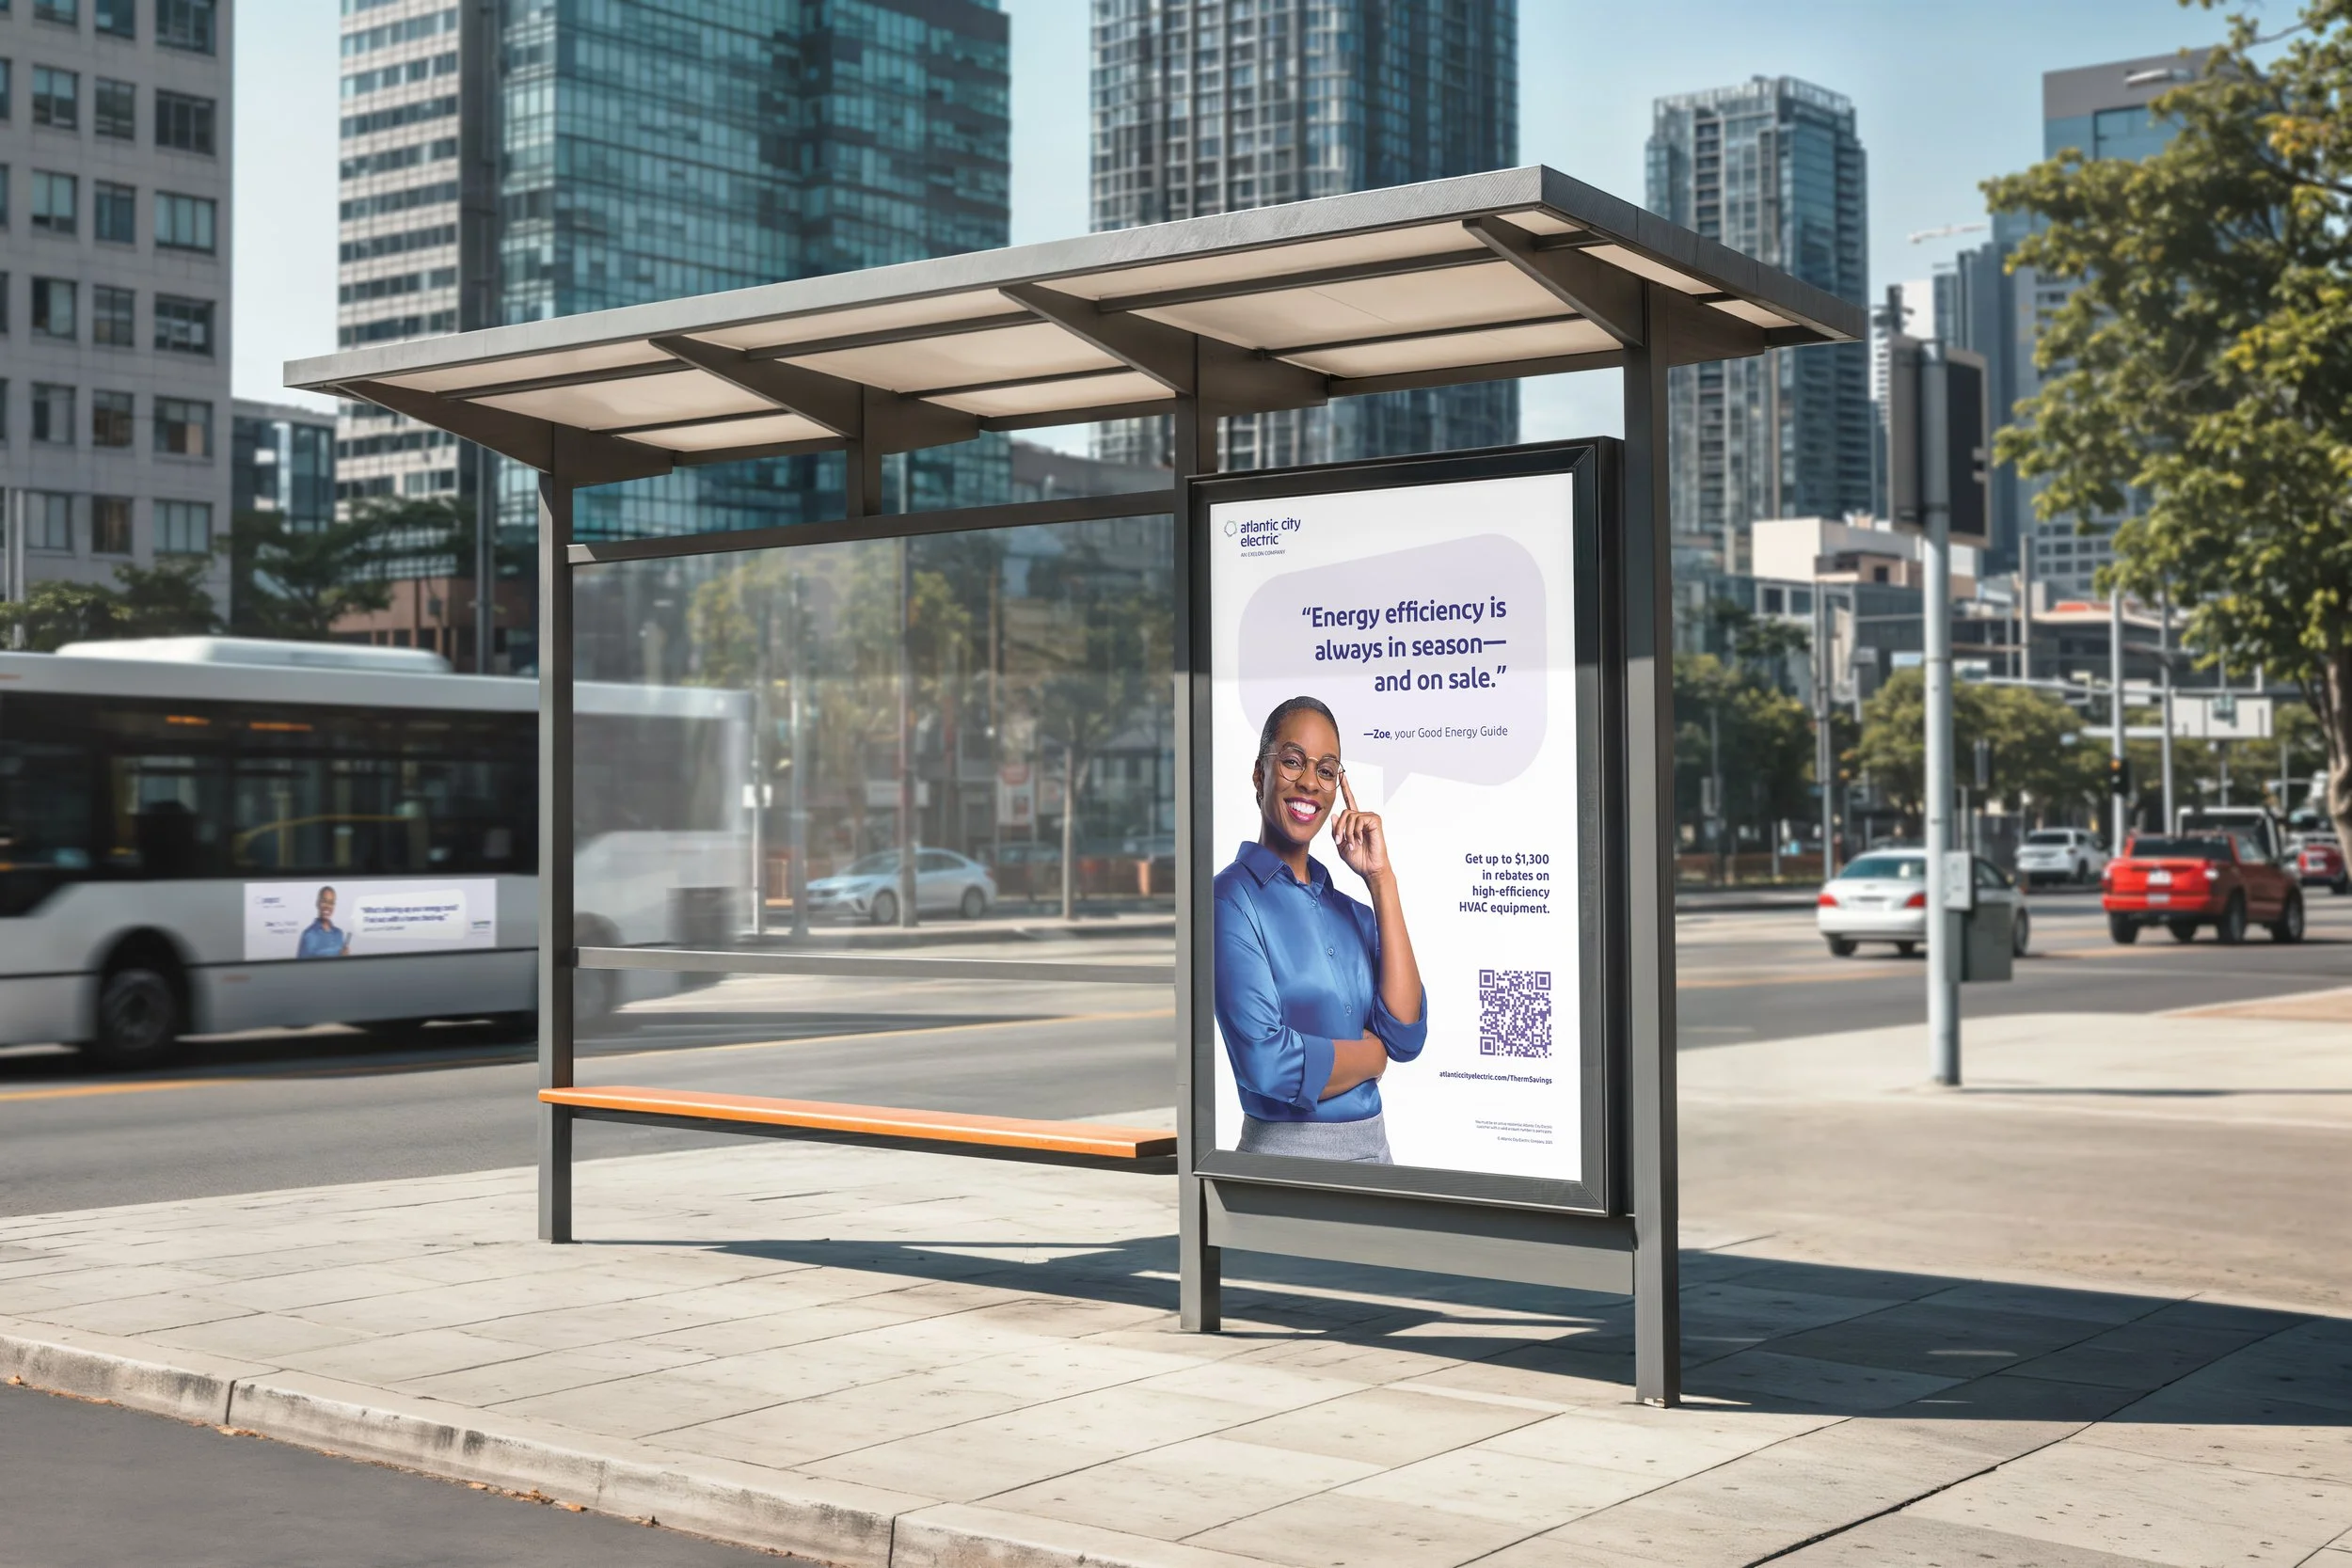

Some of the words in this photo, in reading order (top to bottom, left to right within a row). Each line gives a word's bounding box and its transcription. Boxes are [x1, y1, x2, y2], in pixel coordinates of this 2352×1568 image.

[1240, 518, 1279, 533] atlantic
[1281, 516, 1301, 531] city
[1302, 607, 1380, 630] “Energy
[1385, 599, 1485, 624] efficiency
[1490, 596, 1507, 617] is
[1315, 640, 1383, 664] always
[1389, 636, 1406, 657] in
[1375, 670, 1411, 691] and
[1417, 673, 1442, 690] on
[1449, 665, 1507, 689] sale.”
[1394, 730, 1415, 740] your
[1418, 727, 1442, 738] Good
[1445, 727, 1477, 739] Energy
[1480, 726, 1508, 736] Guide
[1466, 853, 1483, 863] Get
[1486, 856, 1499, 866] up
[1502, 854, 1512, 863] to
[1515, 852, 1549, 865] $1,300
[1483, 869, 1492, 880] in
[1495, 869, 1534, 880] rebates
[1472, 885, 1550, 899] high-efficiency
[1459, 901, 1487, 912] HVAC
[1490, 902, 1549, 915] equipment.
[1439, 1071, 1552, 1085] atlanticcityelectric.com/ThermSavings
